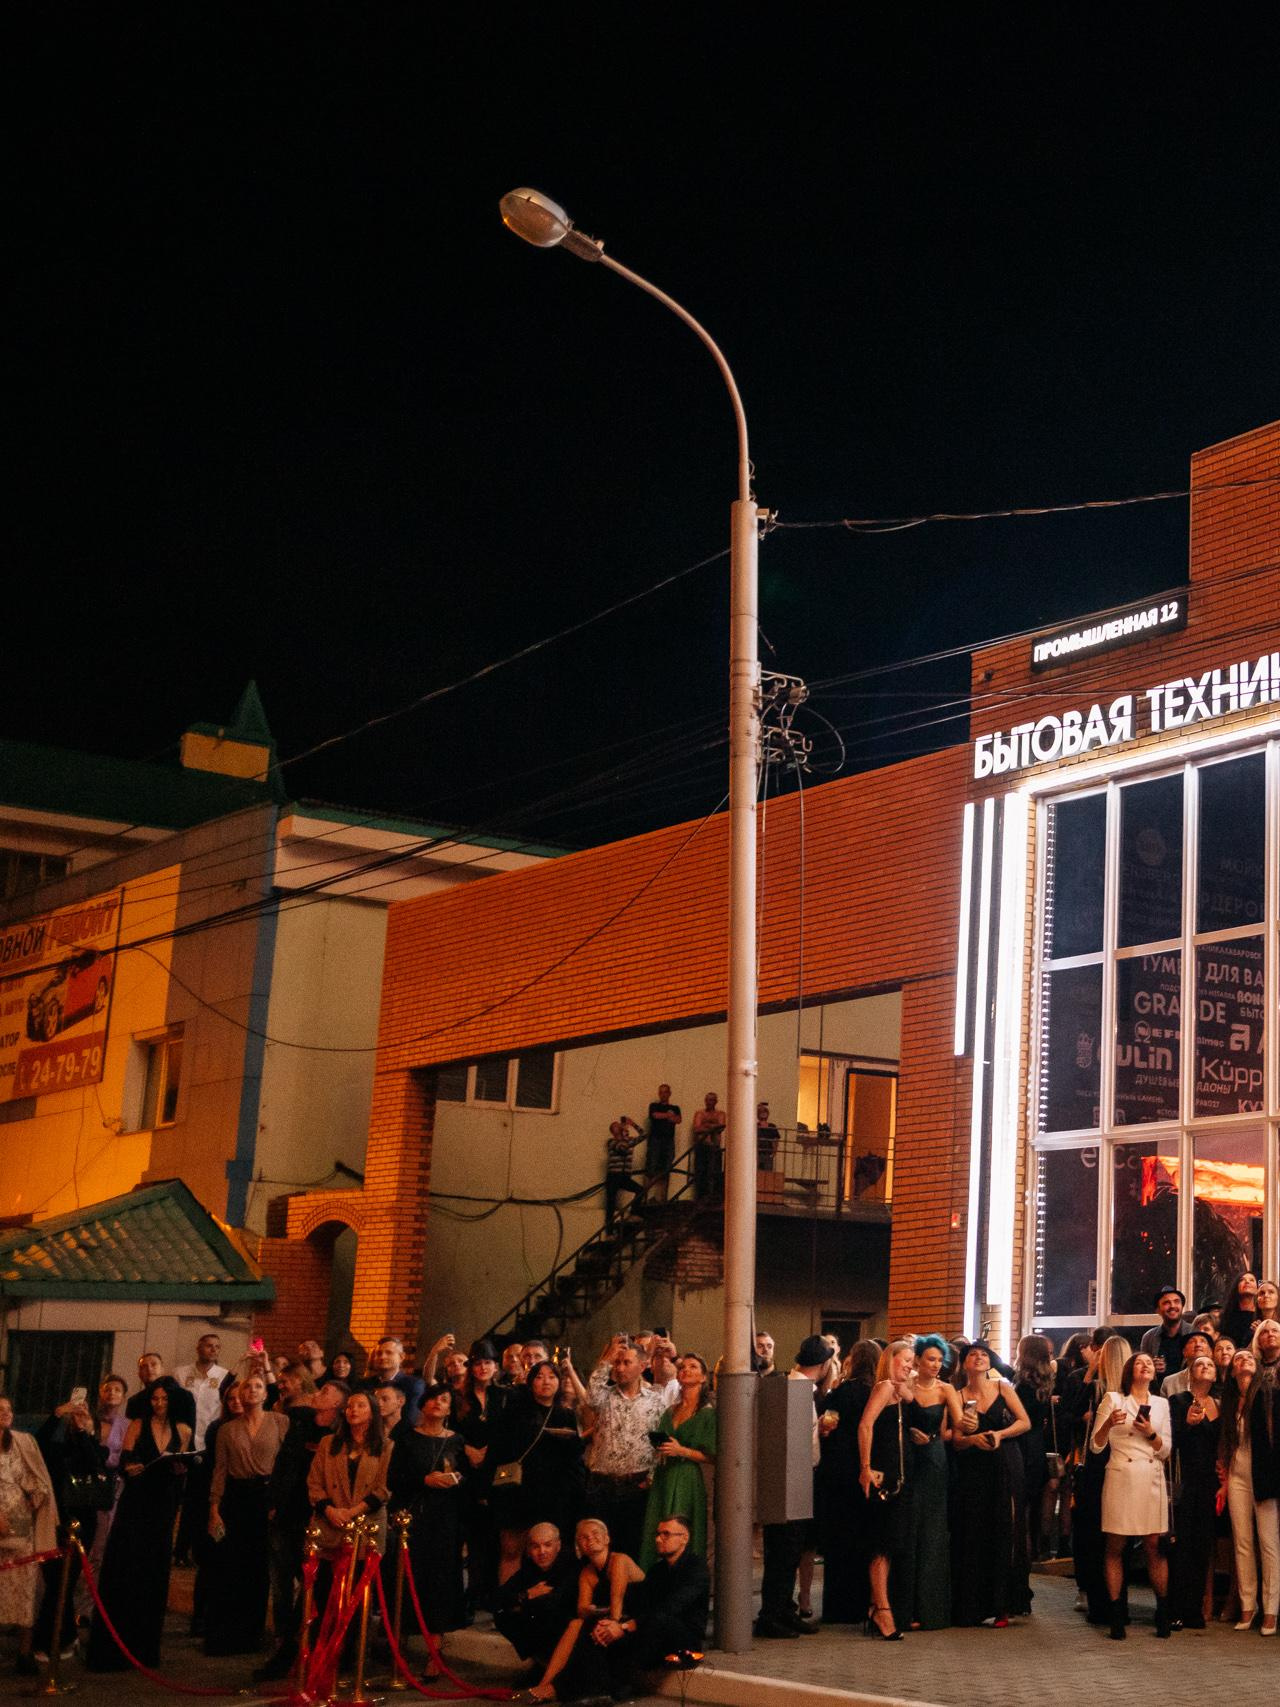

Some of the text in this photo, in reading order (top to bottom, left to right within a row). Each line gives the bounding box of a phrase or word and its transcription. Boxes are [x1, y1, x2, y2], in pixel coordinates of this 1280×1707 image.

[1033, 601, 1179, 663] ПРОМЫШЛЕННАЯ 12
[974, 694, 1134, 779] БЫТОВАЯ
[1134, 989, 1226, 1024] GRADE
[31, 1046, 100, 1089] 24-79-79
